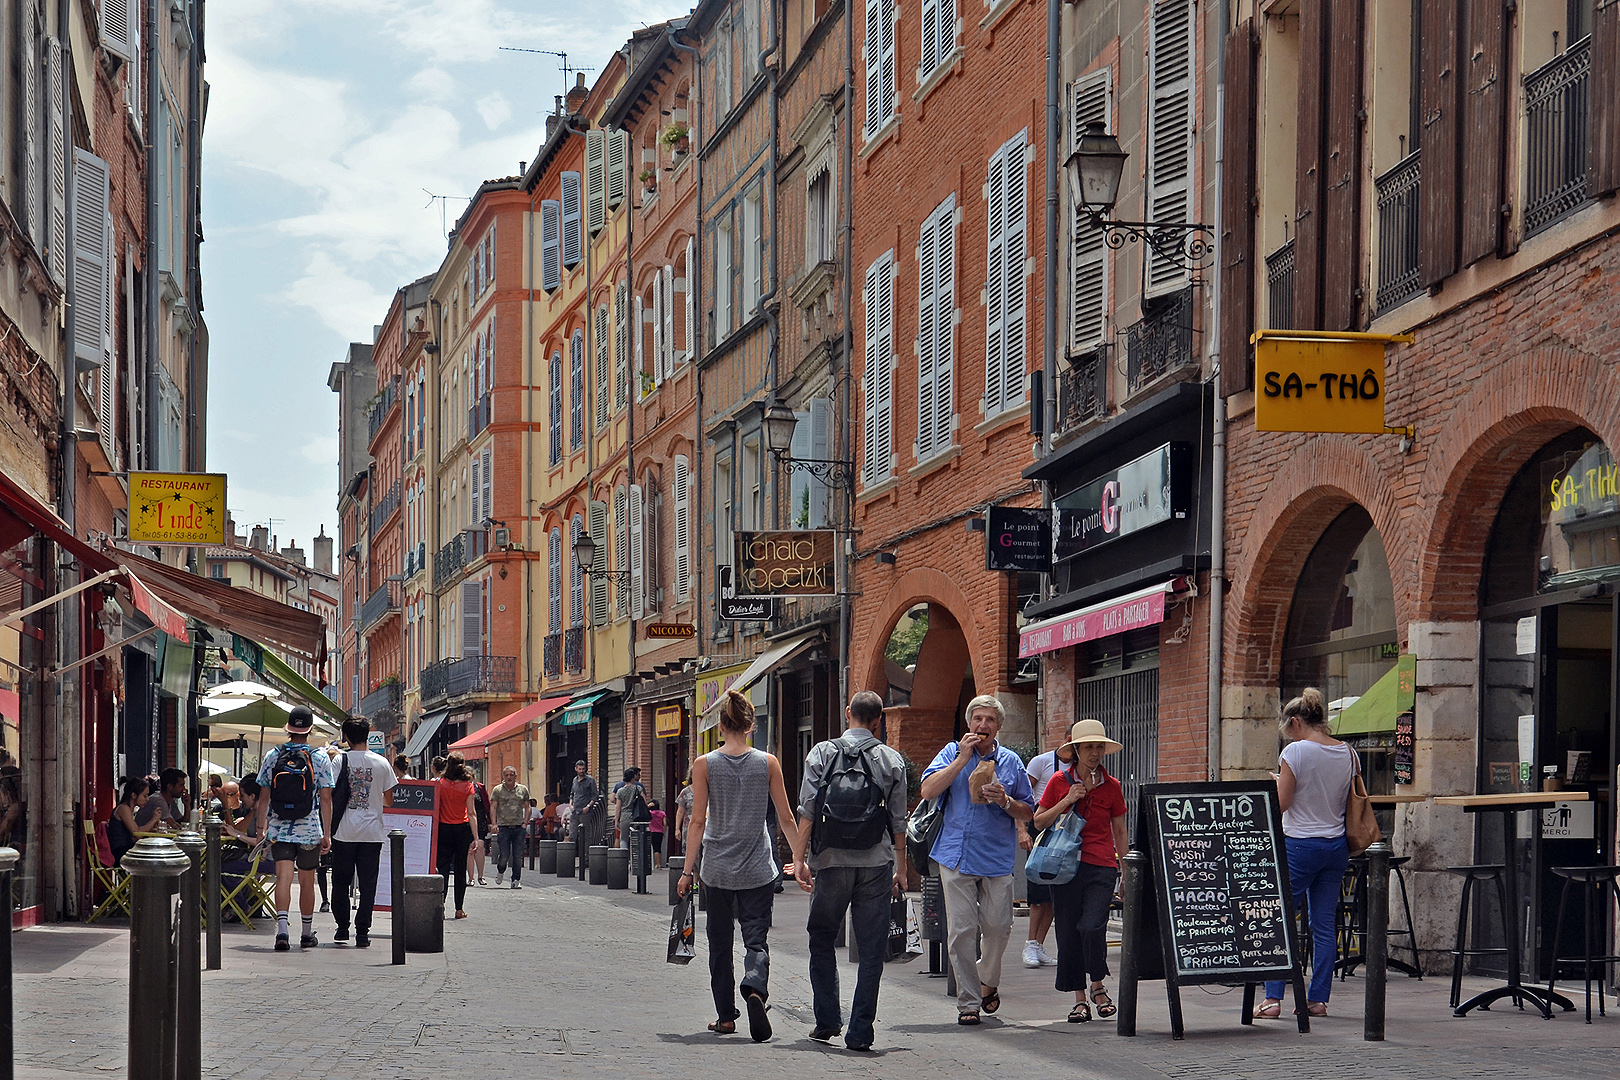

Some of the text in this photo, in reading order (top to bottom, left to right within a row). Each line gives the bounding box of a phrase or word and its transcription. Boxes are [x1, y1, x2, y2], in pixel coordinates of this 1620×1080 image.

[1264, 368, 1379, 400] SA-THÔ
[140, 479, 211, 491] RESTAURANT
[157, 502, 203, 529] l'inde
[1004, 522, 1040, 532] Le point
[1071, 514, 1081, 538] Le
[1082, 507, 1102, 539] point
[152, 532, 207, 540] 05-61-53-86-01
[1000, 533, 1040, 547] Gourmet
[740, 534, 815, 560] richard
[740, 561, 826, 592] kopetzki
[1103, 610, 1118, 631] PLATS
[1123, 601, 1150, 626] PARTAGER
[651, 627, 692, 635] NICOLAS
[1063, 624, 1072, 642] BAR
[1076, 619, 1086, 639] VINS
[1029, 629, 1052, 651] RESTAURANT
[1165, 794, 1254, 820] SA-THÔ
[1172, 819, 1255, 832] Traiteur Asiatique
[1167, 840, 1212, 850] PLATEAU
[1229, 836, 1270, 845] FORMULE
[1238, 899, 1281, 909] FORMULE
[1176, 929, 1186, 937] de
